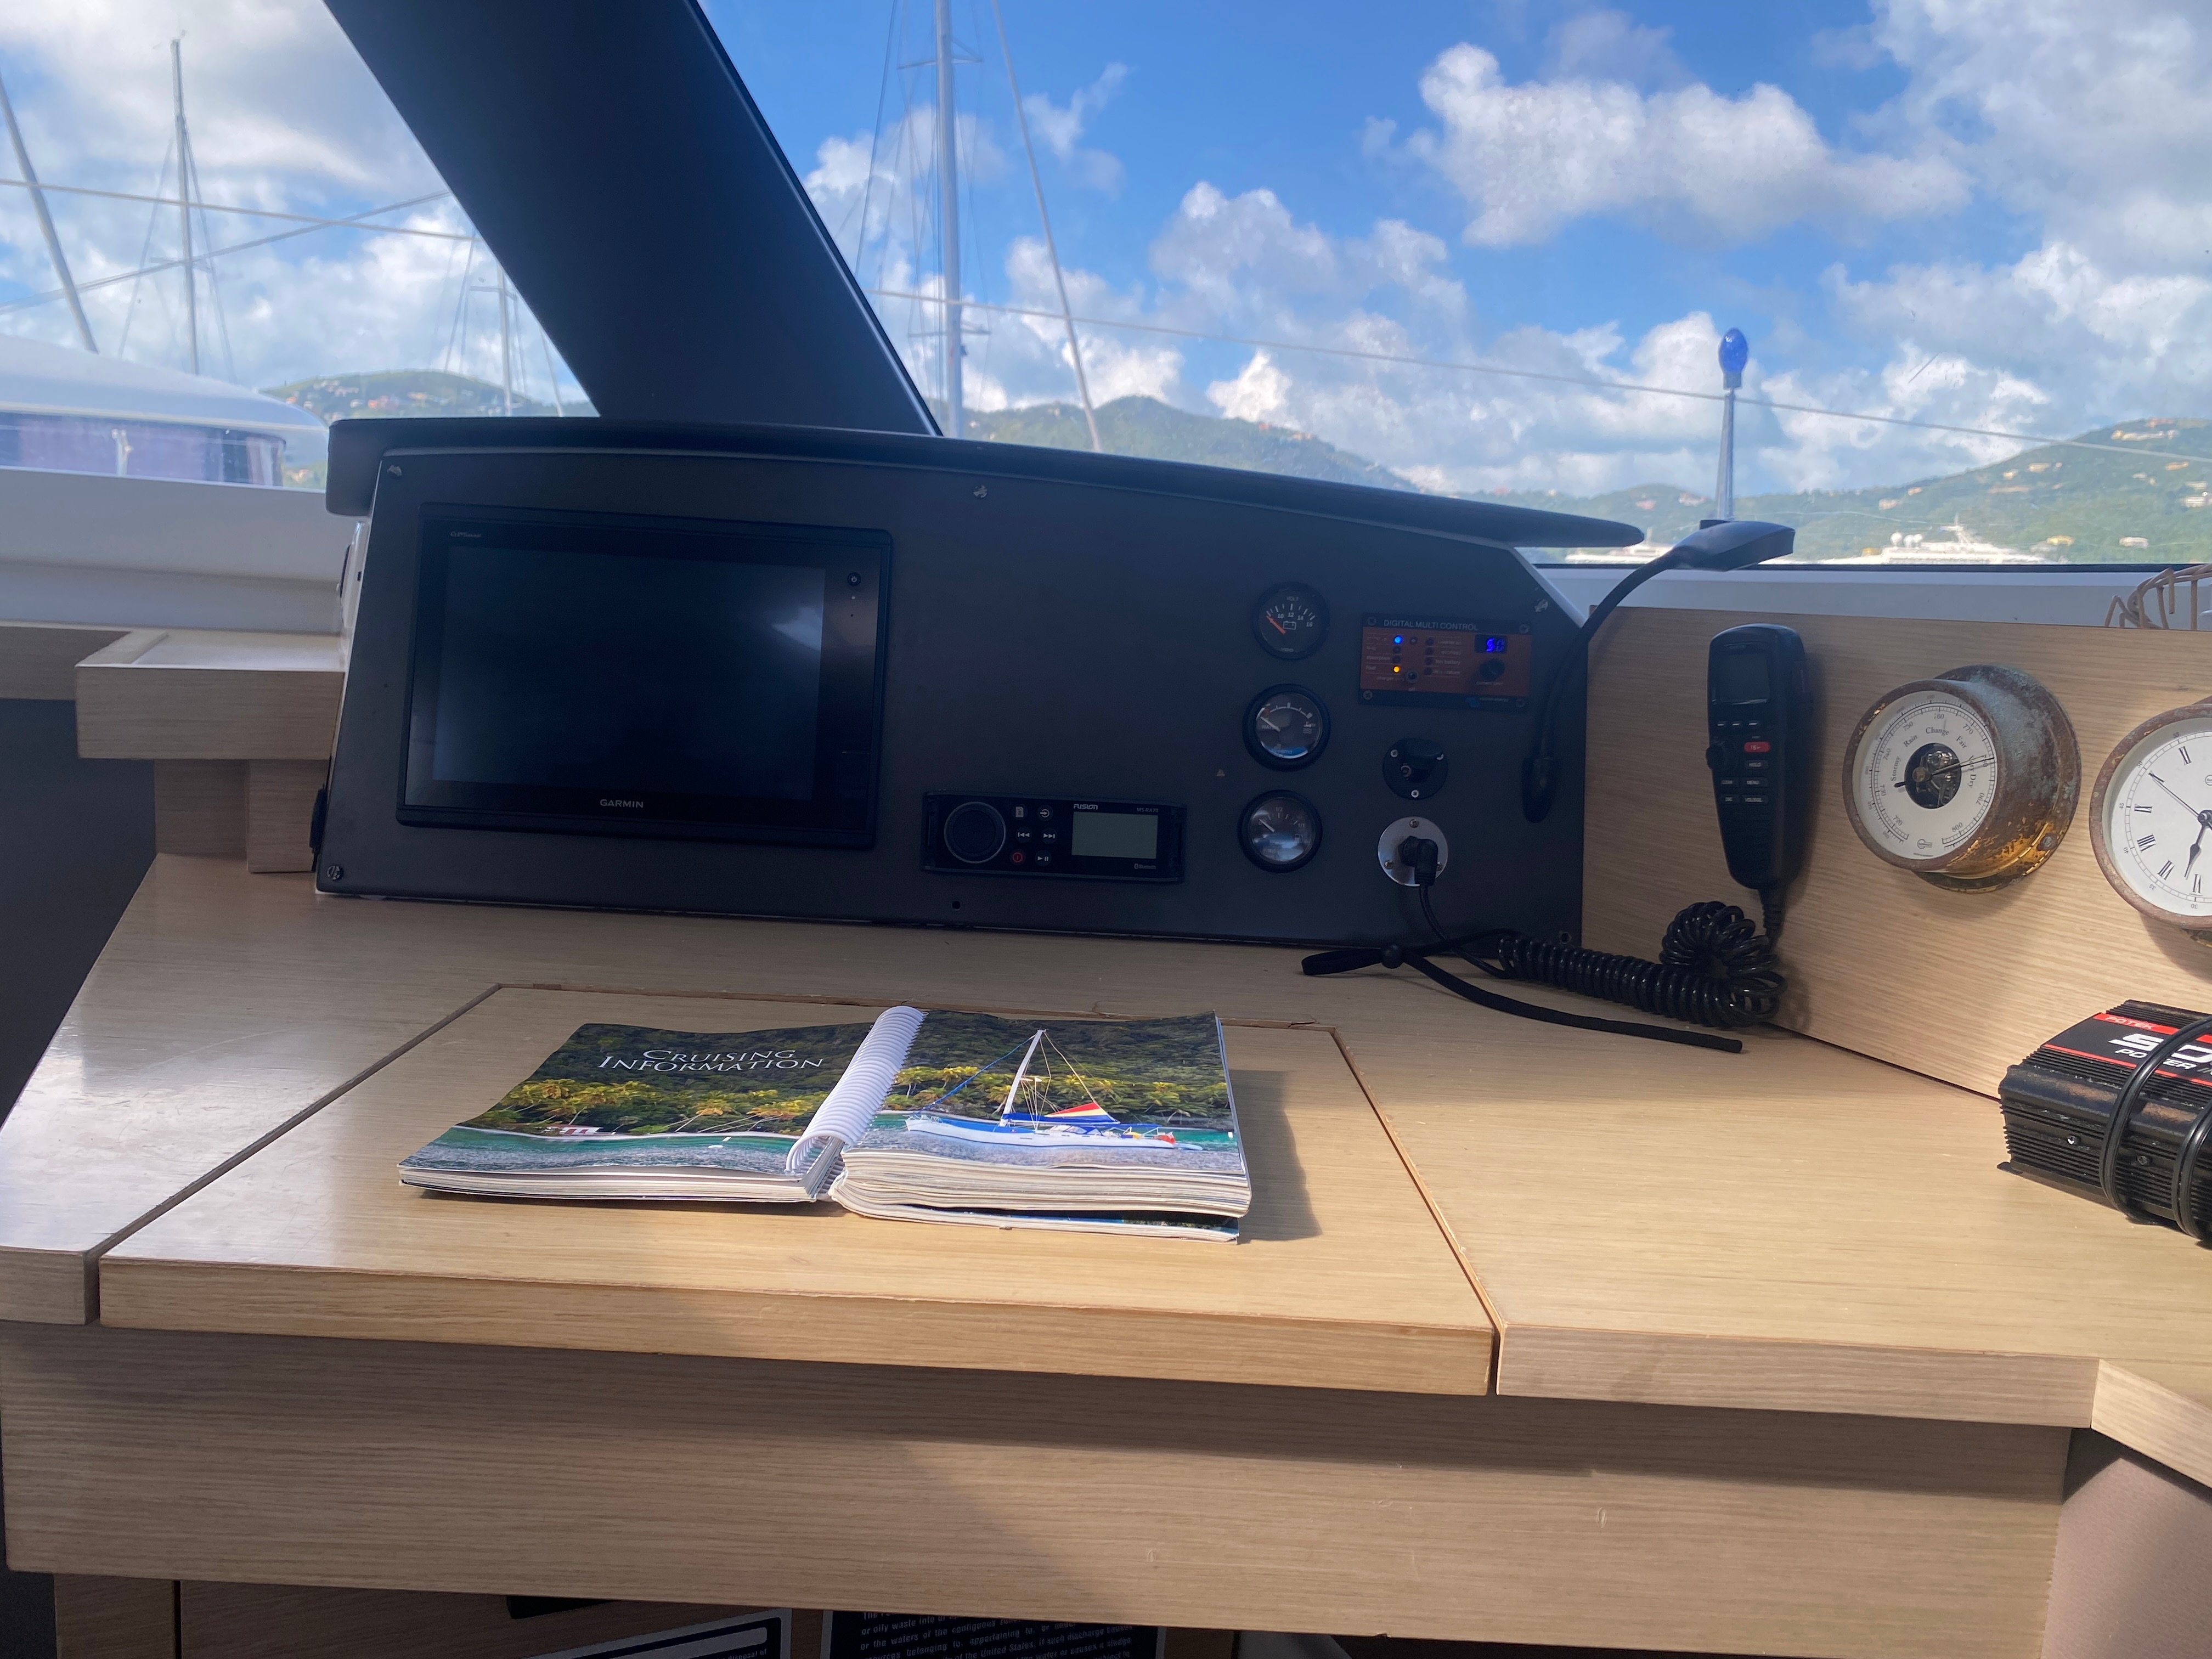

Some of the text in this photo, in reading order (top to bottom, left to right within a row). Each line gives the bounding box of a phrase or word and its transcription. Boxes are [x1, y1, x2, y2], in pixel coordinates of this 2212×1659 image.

[1383, 619, 1414, 628] DIGITAL
[1440, 622, 1479, 631] CONTROL
[1902, 721, 1915, 732] 750
[1925, 727, 1950, 736] Change
[1962, 723, 1974, 735] 770
[1903, 734, 1918, 748] Rain
[1955, 736, 1968, 749] Fair
[1891, 755, 1902, 782] Stormy
[2136, 760, 2143, 769] 50
[1967, 774, 1977, 789] Dry
[600, 799, 644, 808] GARMIN
[1951, 822, 1963, 832] 800
[2104, 1016, 2156, 1030] POTEK
[642, 1049, 796, 1063] CRUISING
[2114, 1048, 2197, 1070] POER
[597, 1056, 824, 1072] INFORMATION
[873, 1623, 889, 1633] oily
[891, 1619, 916, 1630] waste
[873, 1639, 887, 1648] the
[890, 1634, 919, 1645] waters
[935, 1629, 948, 1637] the
[952, 1620, 996, 1634] contiguous
[906, 1644, 948, 1657] belonging
[969, 1629, 1020, 1646] appertaining
[965, 1649, 978, 1659] the
[980, 1645, 1007, 1657] United
[1066, 1628, 1104, 1641] discharge
[1070, 1644, 1097, 1655] causes
